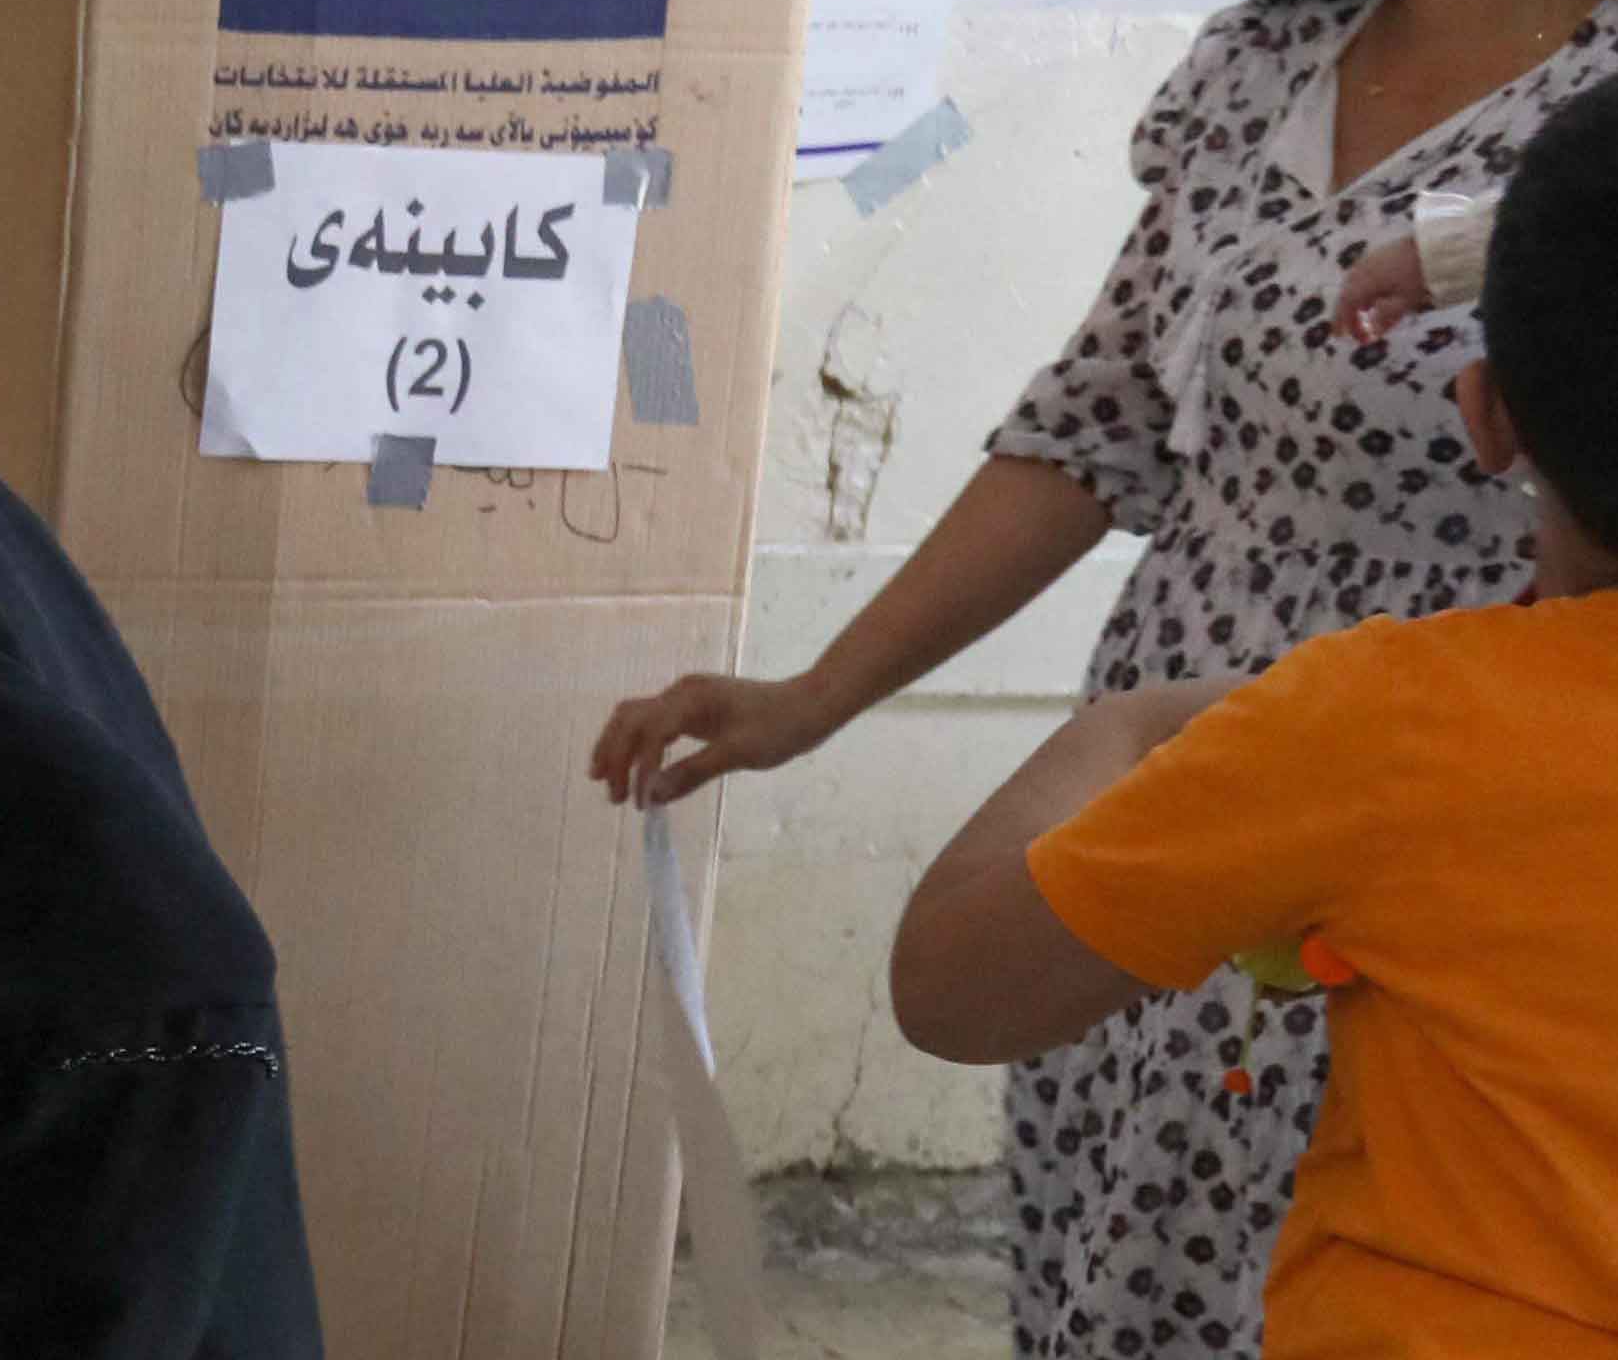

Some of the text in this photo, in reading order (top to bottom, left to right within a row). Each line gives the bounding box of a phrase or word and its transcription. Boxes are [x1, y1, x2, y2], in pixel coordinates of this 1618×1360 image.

[212, 63, 662, 102] المفوضية العليا المستقلة للانتخابات
[384, 335, 473, 415] (2)
